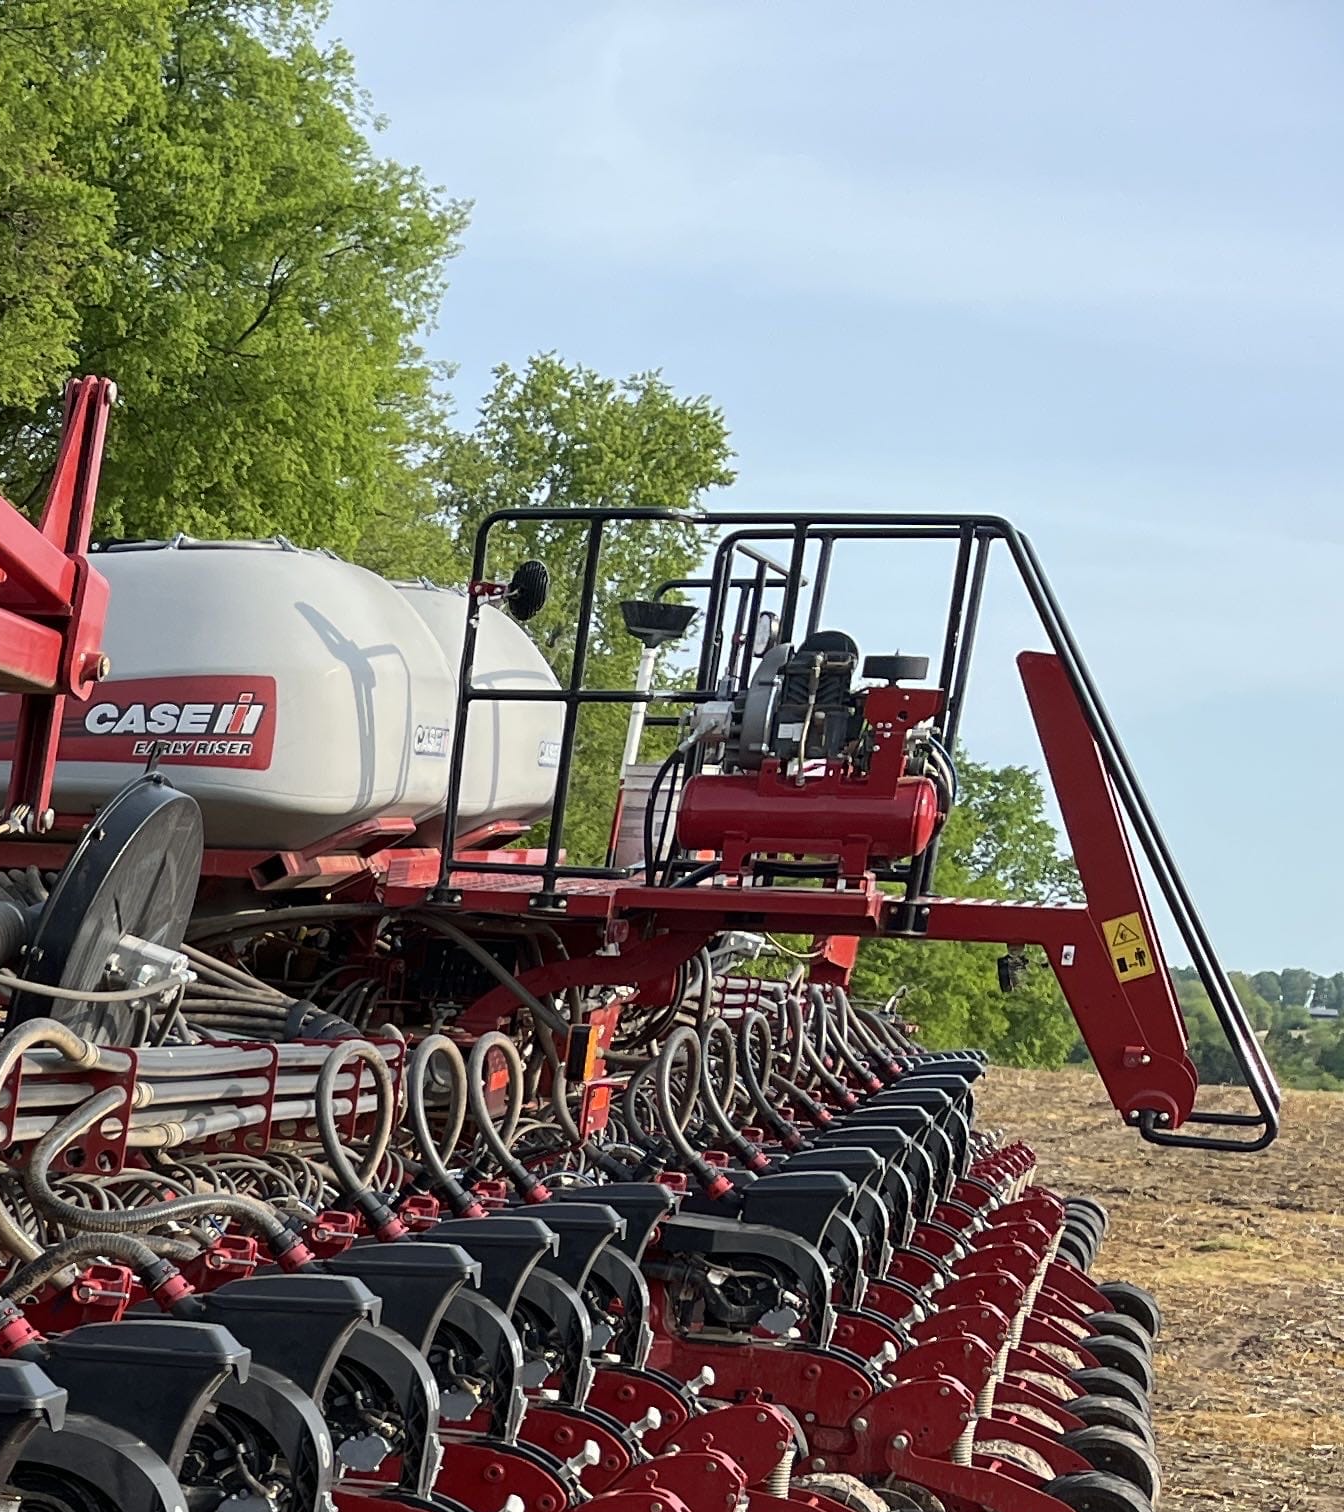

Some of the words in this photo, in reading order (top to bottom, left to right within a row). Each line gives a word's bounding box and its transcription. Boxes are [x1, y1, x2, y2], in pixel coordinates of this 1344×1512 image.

[84, 702, 215, 735] CASE
[194, 740, 253, 757] RISER
[318, 1432, 331, 1469] 8
